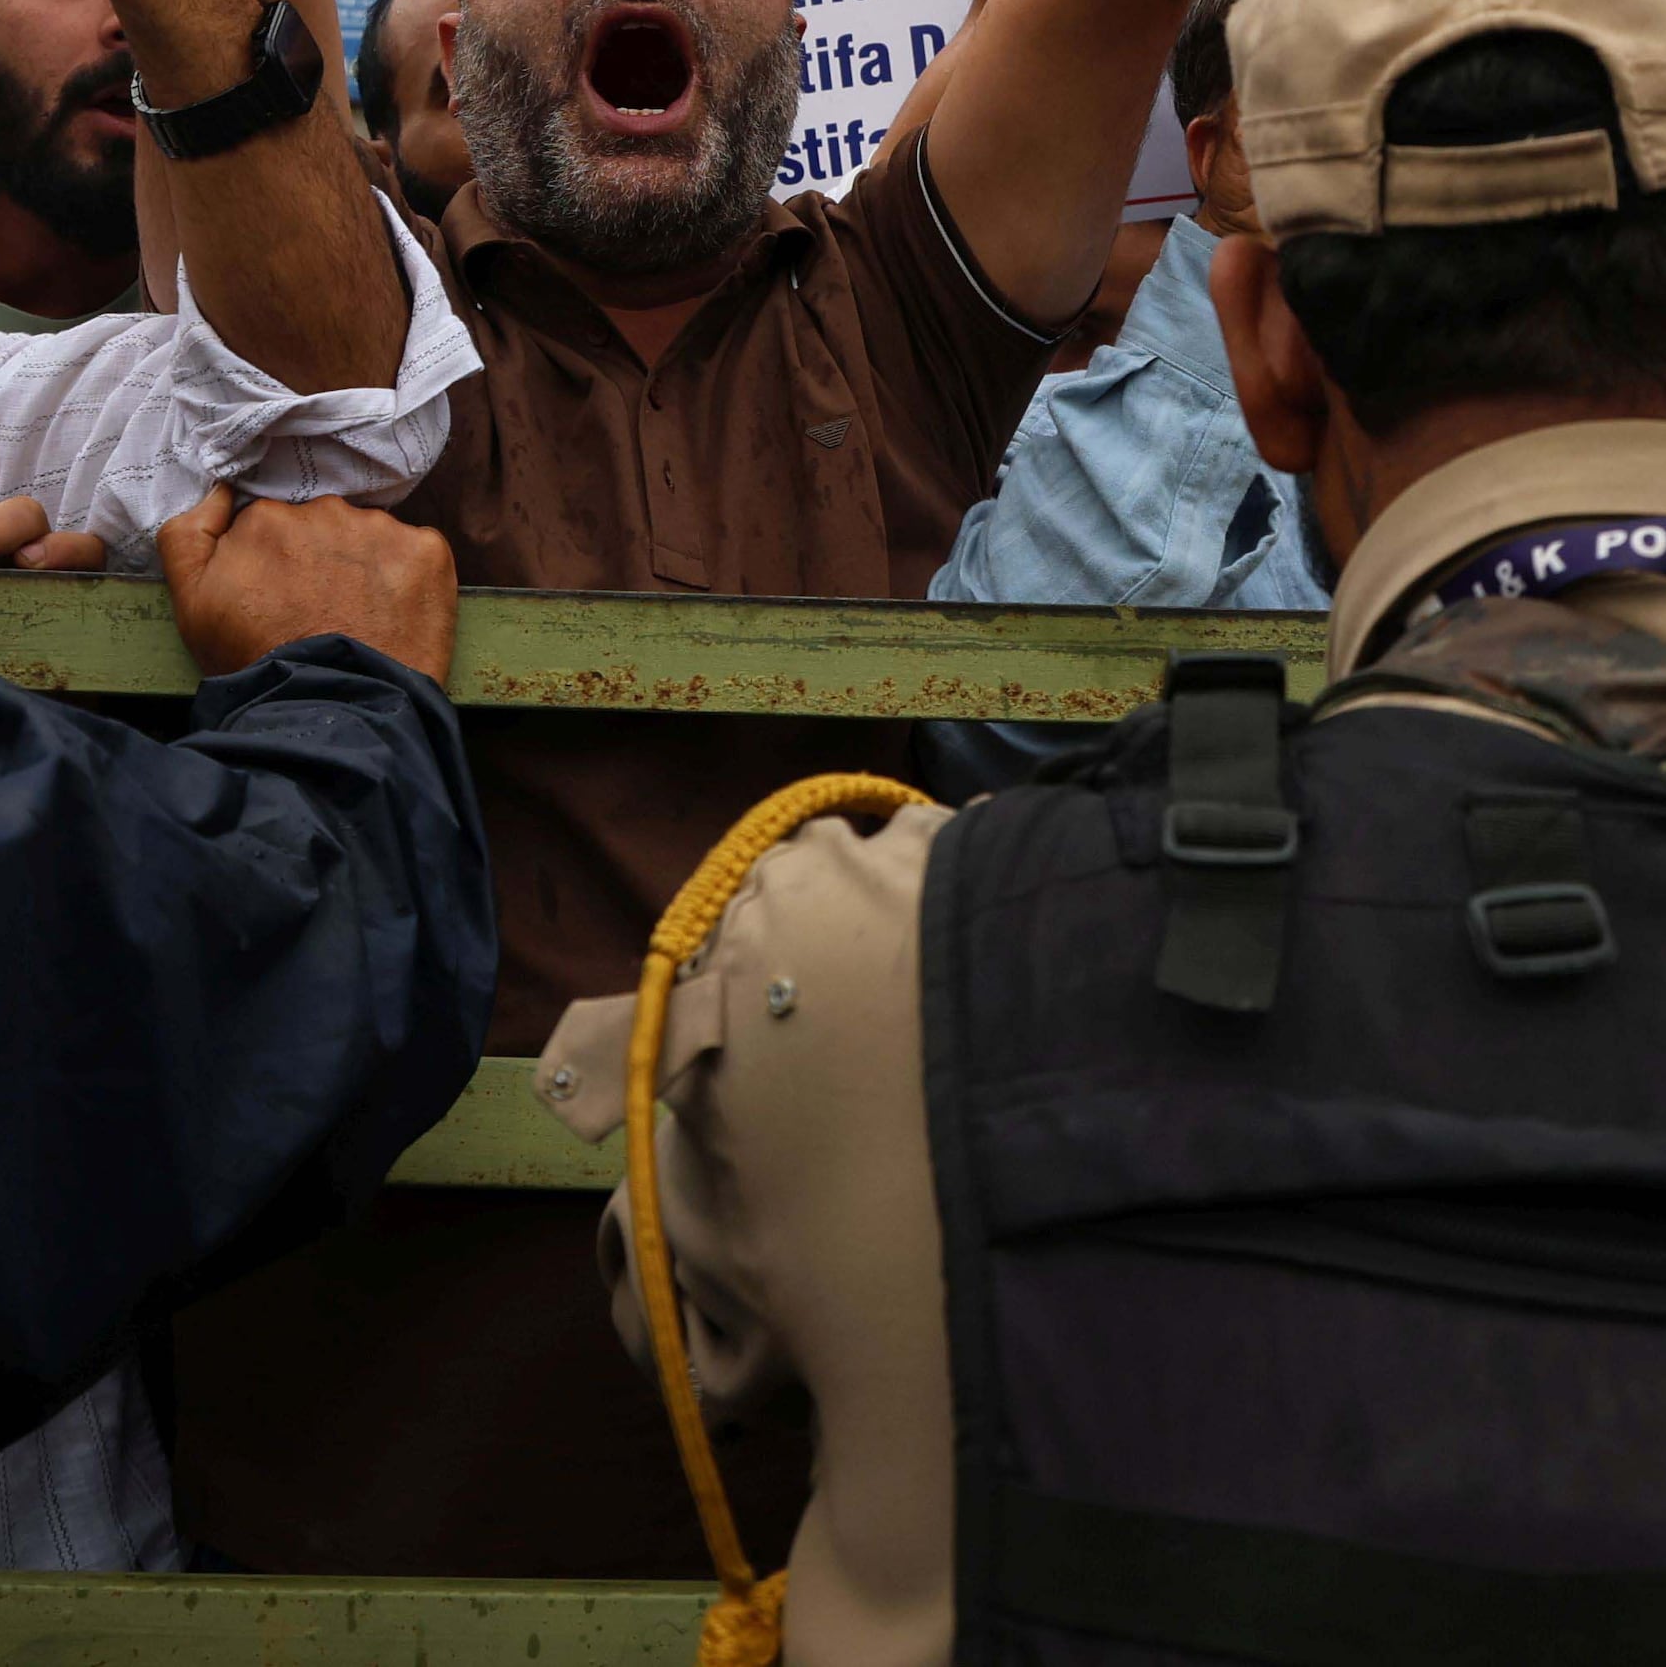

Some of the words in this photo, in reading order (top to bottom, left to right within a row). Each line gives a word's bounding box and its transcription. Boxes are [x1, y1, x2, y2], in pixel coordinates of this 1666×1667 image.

[800, 33, 894, 94] tifa
[910, 23, 946, 80] D
[776, 120, 886, 185] stif
